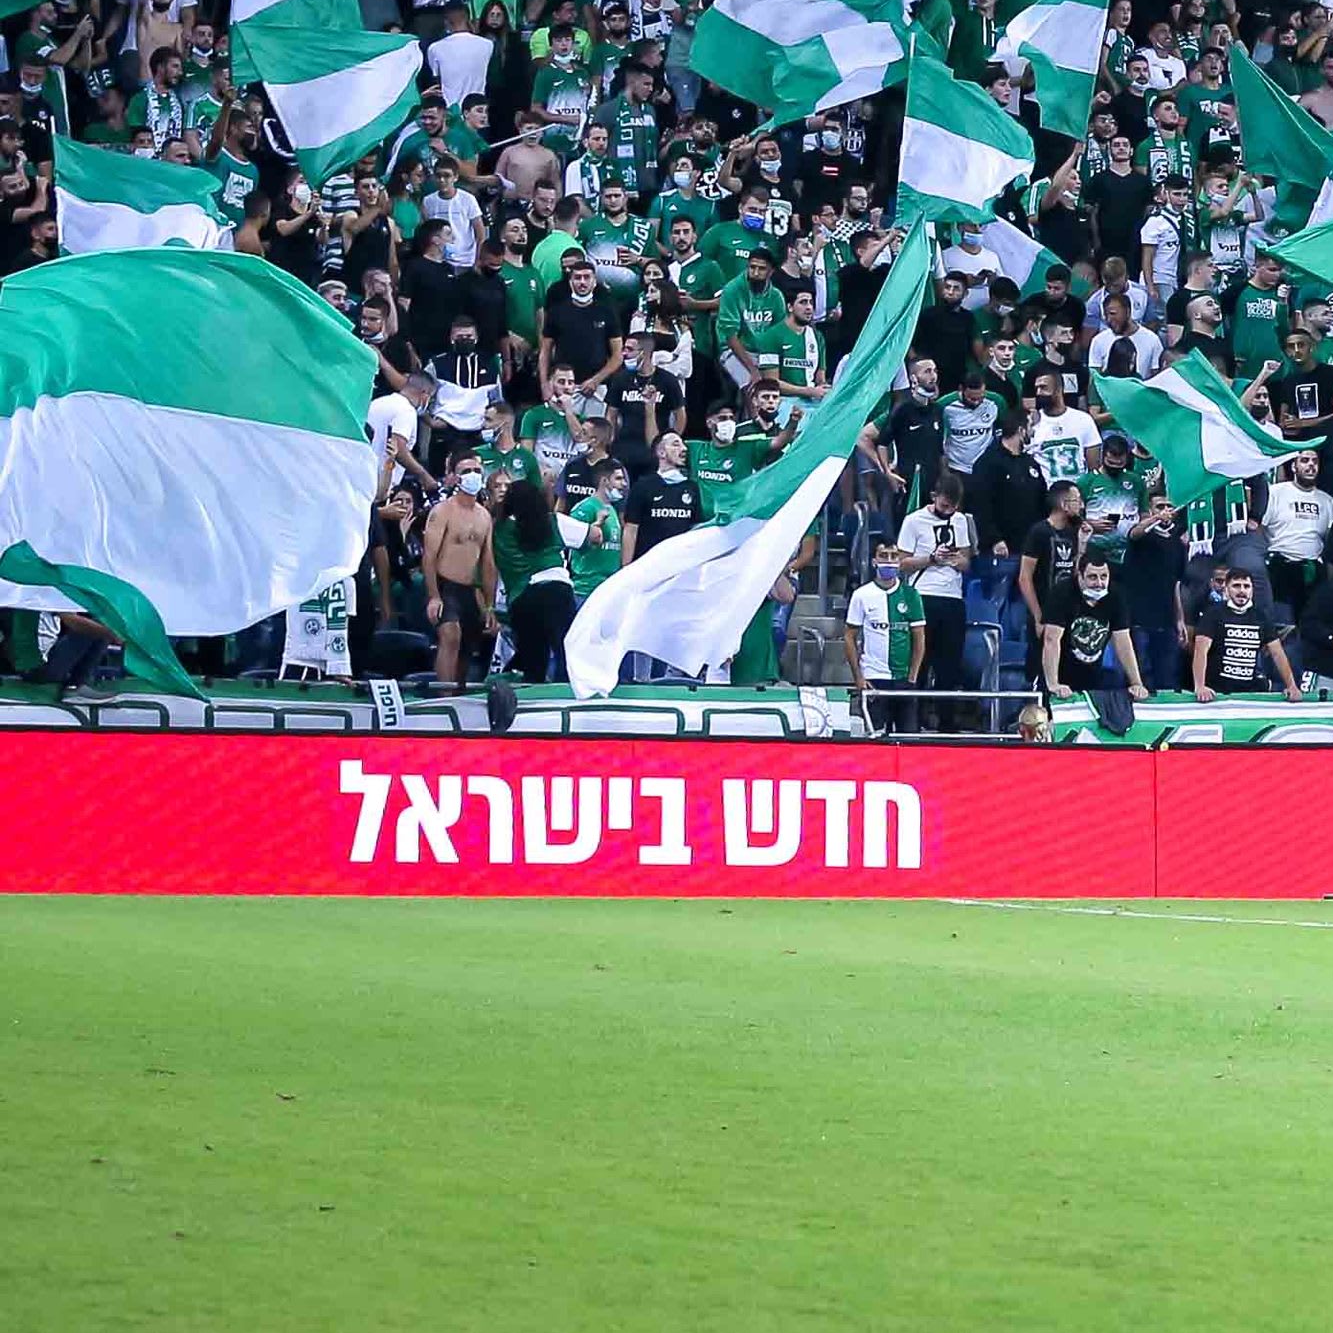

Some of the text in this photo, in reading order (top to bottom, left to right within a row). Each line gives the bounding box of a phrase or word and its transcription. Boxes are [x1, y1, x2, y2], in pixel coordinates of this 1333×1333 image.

[764, 211, 791, 237] 13
[783, 357, 814, 370] HONDA
[1045, 446, 1081, 478] 13
[697, 469, 734, 484] HONDA
[651, 507, 693, 520] HONDA
[1296, 502, 1320, 515] Lee
[1226, 628, 1261, 640] adidas
[376, 683, 398, 729] חיפה
[339, 759, 921, 869] חדש בישראל
